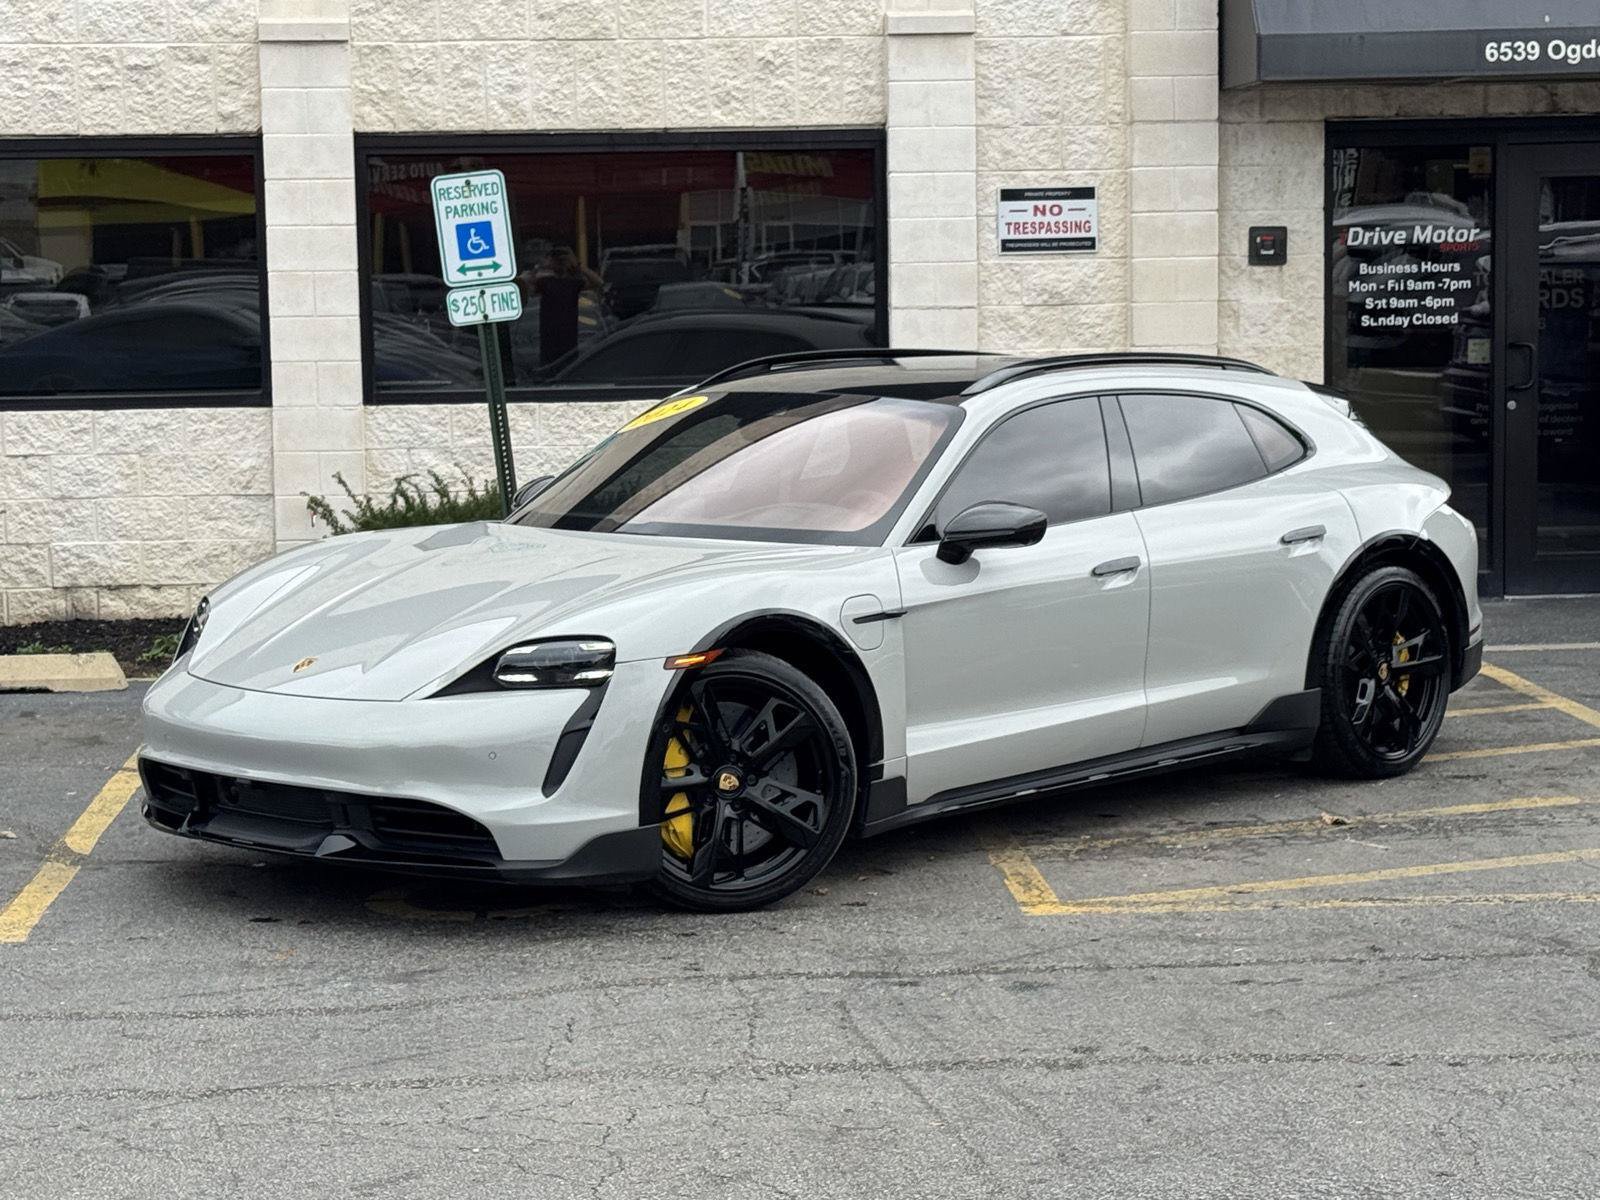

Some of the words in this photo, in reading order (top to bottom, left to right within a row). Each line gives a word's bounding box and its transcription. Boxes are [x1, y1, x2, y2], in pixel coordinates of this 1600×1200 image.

[1485, 40, 1540, 62] 6539
[1547, 38, 1600, 65] Ogd
[438, 181, 499, 202] RESERVED
[445, 201, 498, 219] PARKING
[1033, 204, 1063, 217] NO
[1005, 220, 1092, 235] TRESPASSING
[1413, 225, 1480, 245] Motor
[1440, 243, 1480, 252] SPORTS
[1359, 263, 1418, 275] Business
[1421, 261, 1461, 273] Hours
[1348, 280, 1377, 292] Mon
[1406, 279, 1435, 291] 9am
[451, 294, 487, 317] $250
[491, 291, 518, 313] FINE
[1389, 297, 1418, 309] 9am
[1412, 312, 1459, 326] Closed
